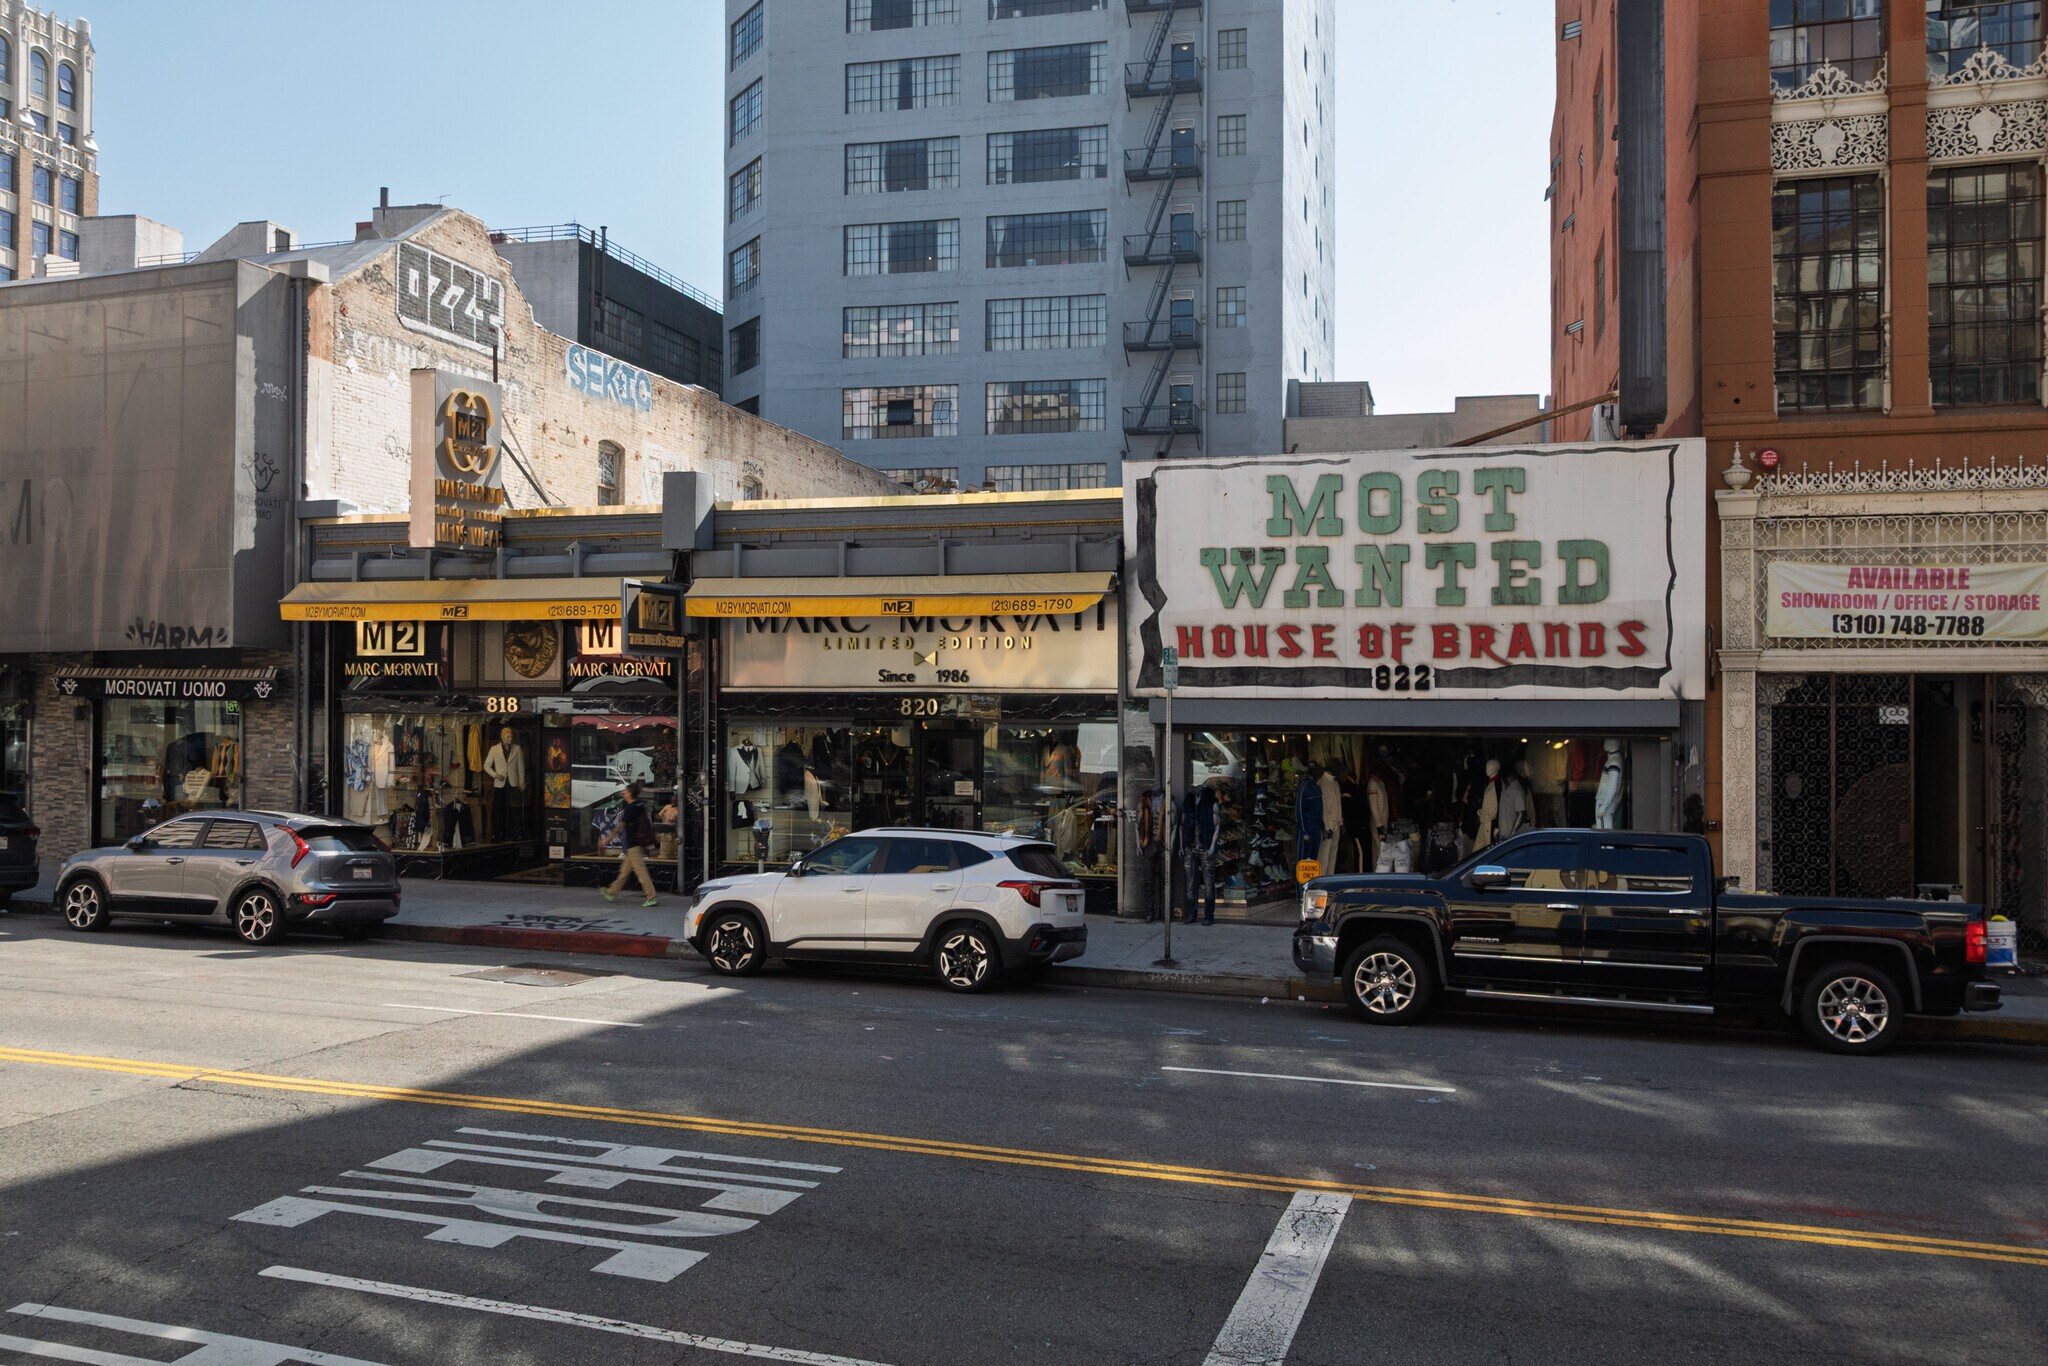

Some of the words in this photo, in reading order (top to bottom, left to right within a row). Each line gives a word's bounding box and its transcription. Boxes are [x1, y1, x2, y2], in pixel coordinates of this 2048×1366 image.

[1266, 467, 1526, 537] MOST
[1199, 540, 1610, 609] WANTED
[1847, 566, 1971, 590] AVAILABLE
[716, 601, 791, 614] M2BYMORVATI.COM
[883, 601, 913, 613] M2
[1781, 591, 1878, 610] SHOWROOM
[1893, 594, 1948, 611] OFFICE
[1964, 594, 2041, 611] STORAGE
[305, 606, 366, 618] M2BYMORVATI.COM
[442, 605, 468, 618] M2
[644, 599, 671, 626] M2
[136, 617, 214, 649] HARM
[1832, 613, 1885, 635] (310)
[1890, 615, 1985, 636] 748-7788
[362, 621, 416, 651] M2
[667, 635, 685, 648] SHOP
[823, 636, 914, 650] LIMITED
[939, 636, 1032, 650] EDITION
[1175, 624, 1339, 659] HOUSE
[1358, 624, 1415, 665] OF
[1431, 620, 1649, 666] BRANDS
[344, 662, 380, 676] MARC
[384, 662, 438, 677] MORVATI
[570, 662, 608, 677] MARC
[613, 662, 672, 677] MORVATI
[878, 669, 916, 683] Since
[936, 669, 970, 683] 1986
[1374, 664, 1431, 691] 822
[105, 680, 176, 697] MOROVATI
[183, 681, 226, 697] UOMO
[487, 696, 518, 713] 818
[900, 698, 939, 716] 820
